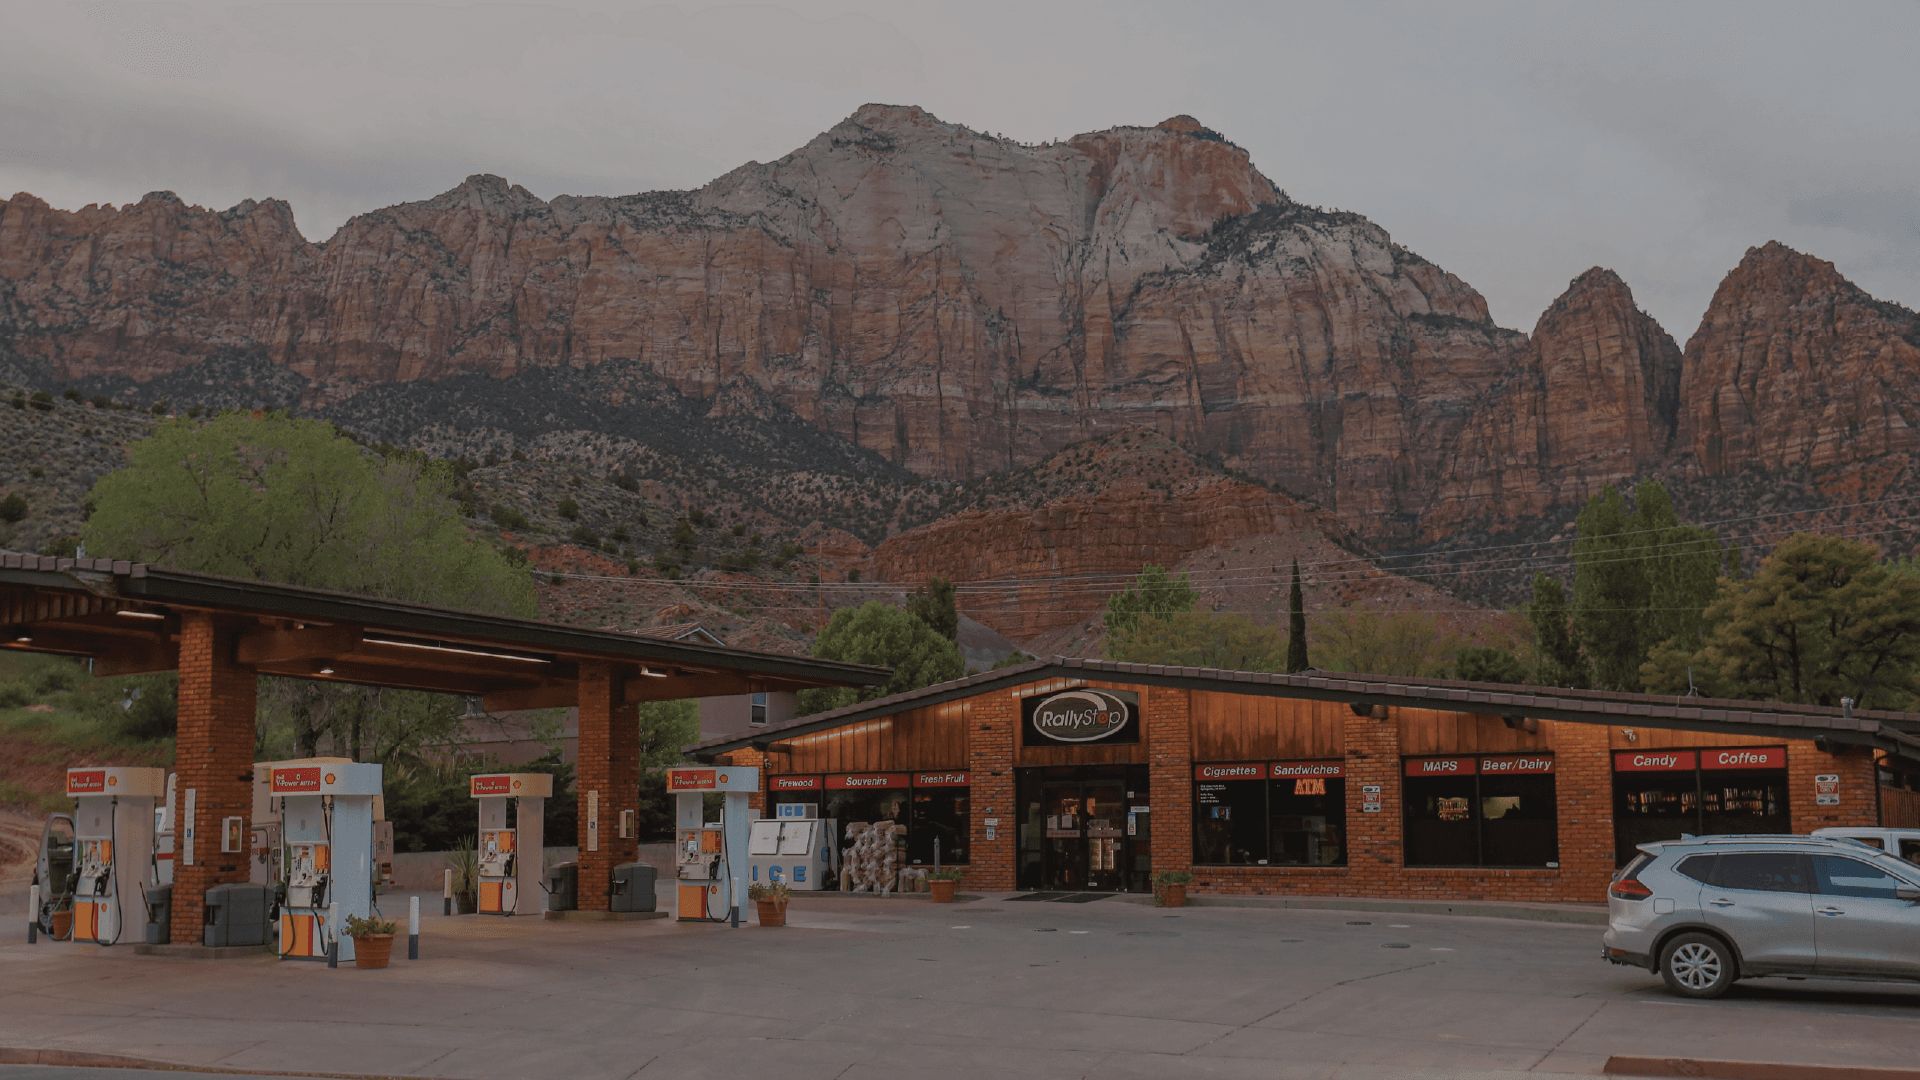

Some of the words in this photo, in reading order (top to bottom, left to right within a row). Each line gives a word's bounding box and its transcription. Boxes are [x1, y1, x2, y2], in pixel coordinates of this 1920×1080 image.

[1041, 709, 1121, 730] RallyStop
[1633, 754, 1677, 768] Candy
[1718, 752, 1768, 764] Coffee
[1273, 765, 1340, 775] Sandwiches
[1423, 760, 1458, 772] MAPS
[1482, 758, 1552, 771] Beer/Dairy
[1203, 766, 1257, 778] Cigarettes
[778, 778, 814, 787] Firewood
[845, 776, 888, 786] Souvenirs
[920, 774, 944, 784] Fresh
[945, 773, 965, 783] Fruit
[1294, 778, 1326, 795] ATM
[778, 805, 804, 817] ICE
[752, 865, 807, 882] ICE
